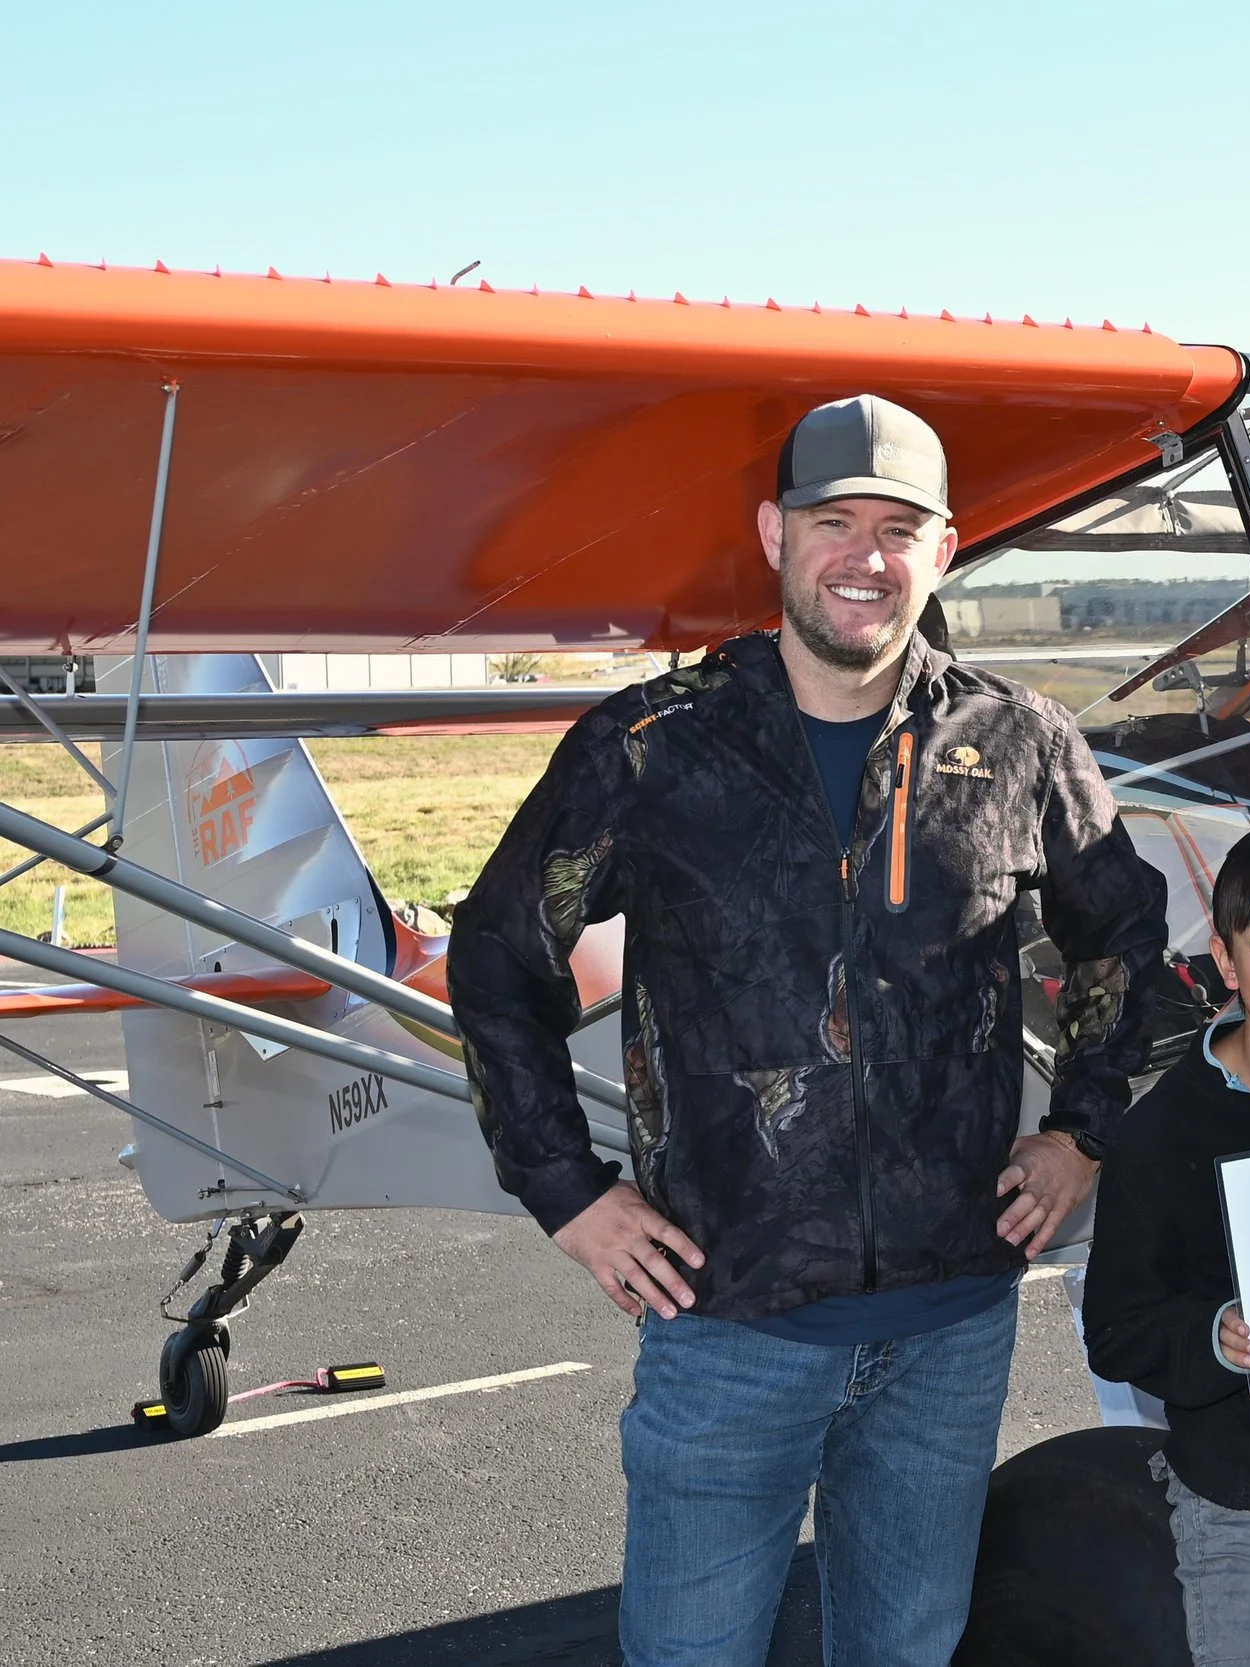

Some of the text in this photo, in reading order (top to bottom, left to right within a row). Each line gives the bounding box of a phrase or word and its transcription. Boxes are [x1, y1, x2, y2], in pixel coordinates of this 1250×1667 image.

[629, 702, 694, 734] SCENT-FACTOR
[936, 763, 991, 778] MOSSY OAK
[199, 797, 256, 865] RAF
[328, 1073, 388, 1135] N59XX
